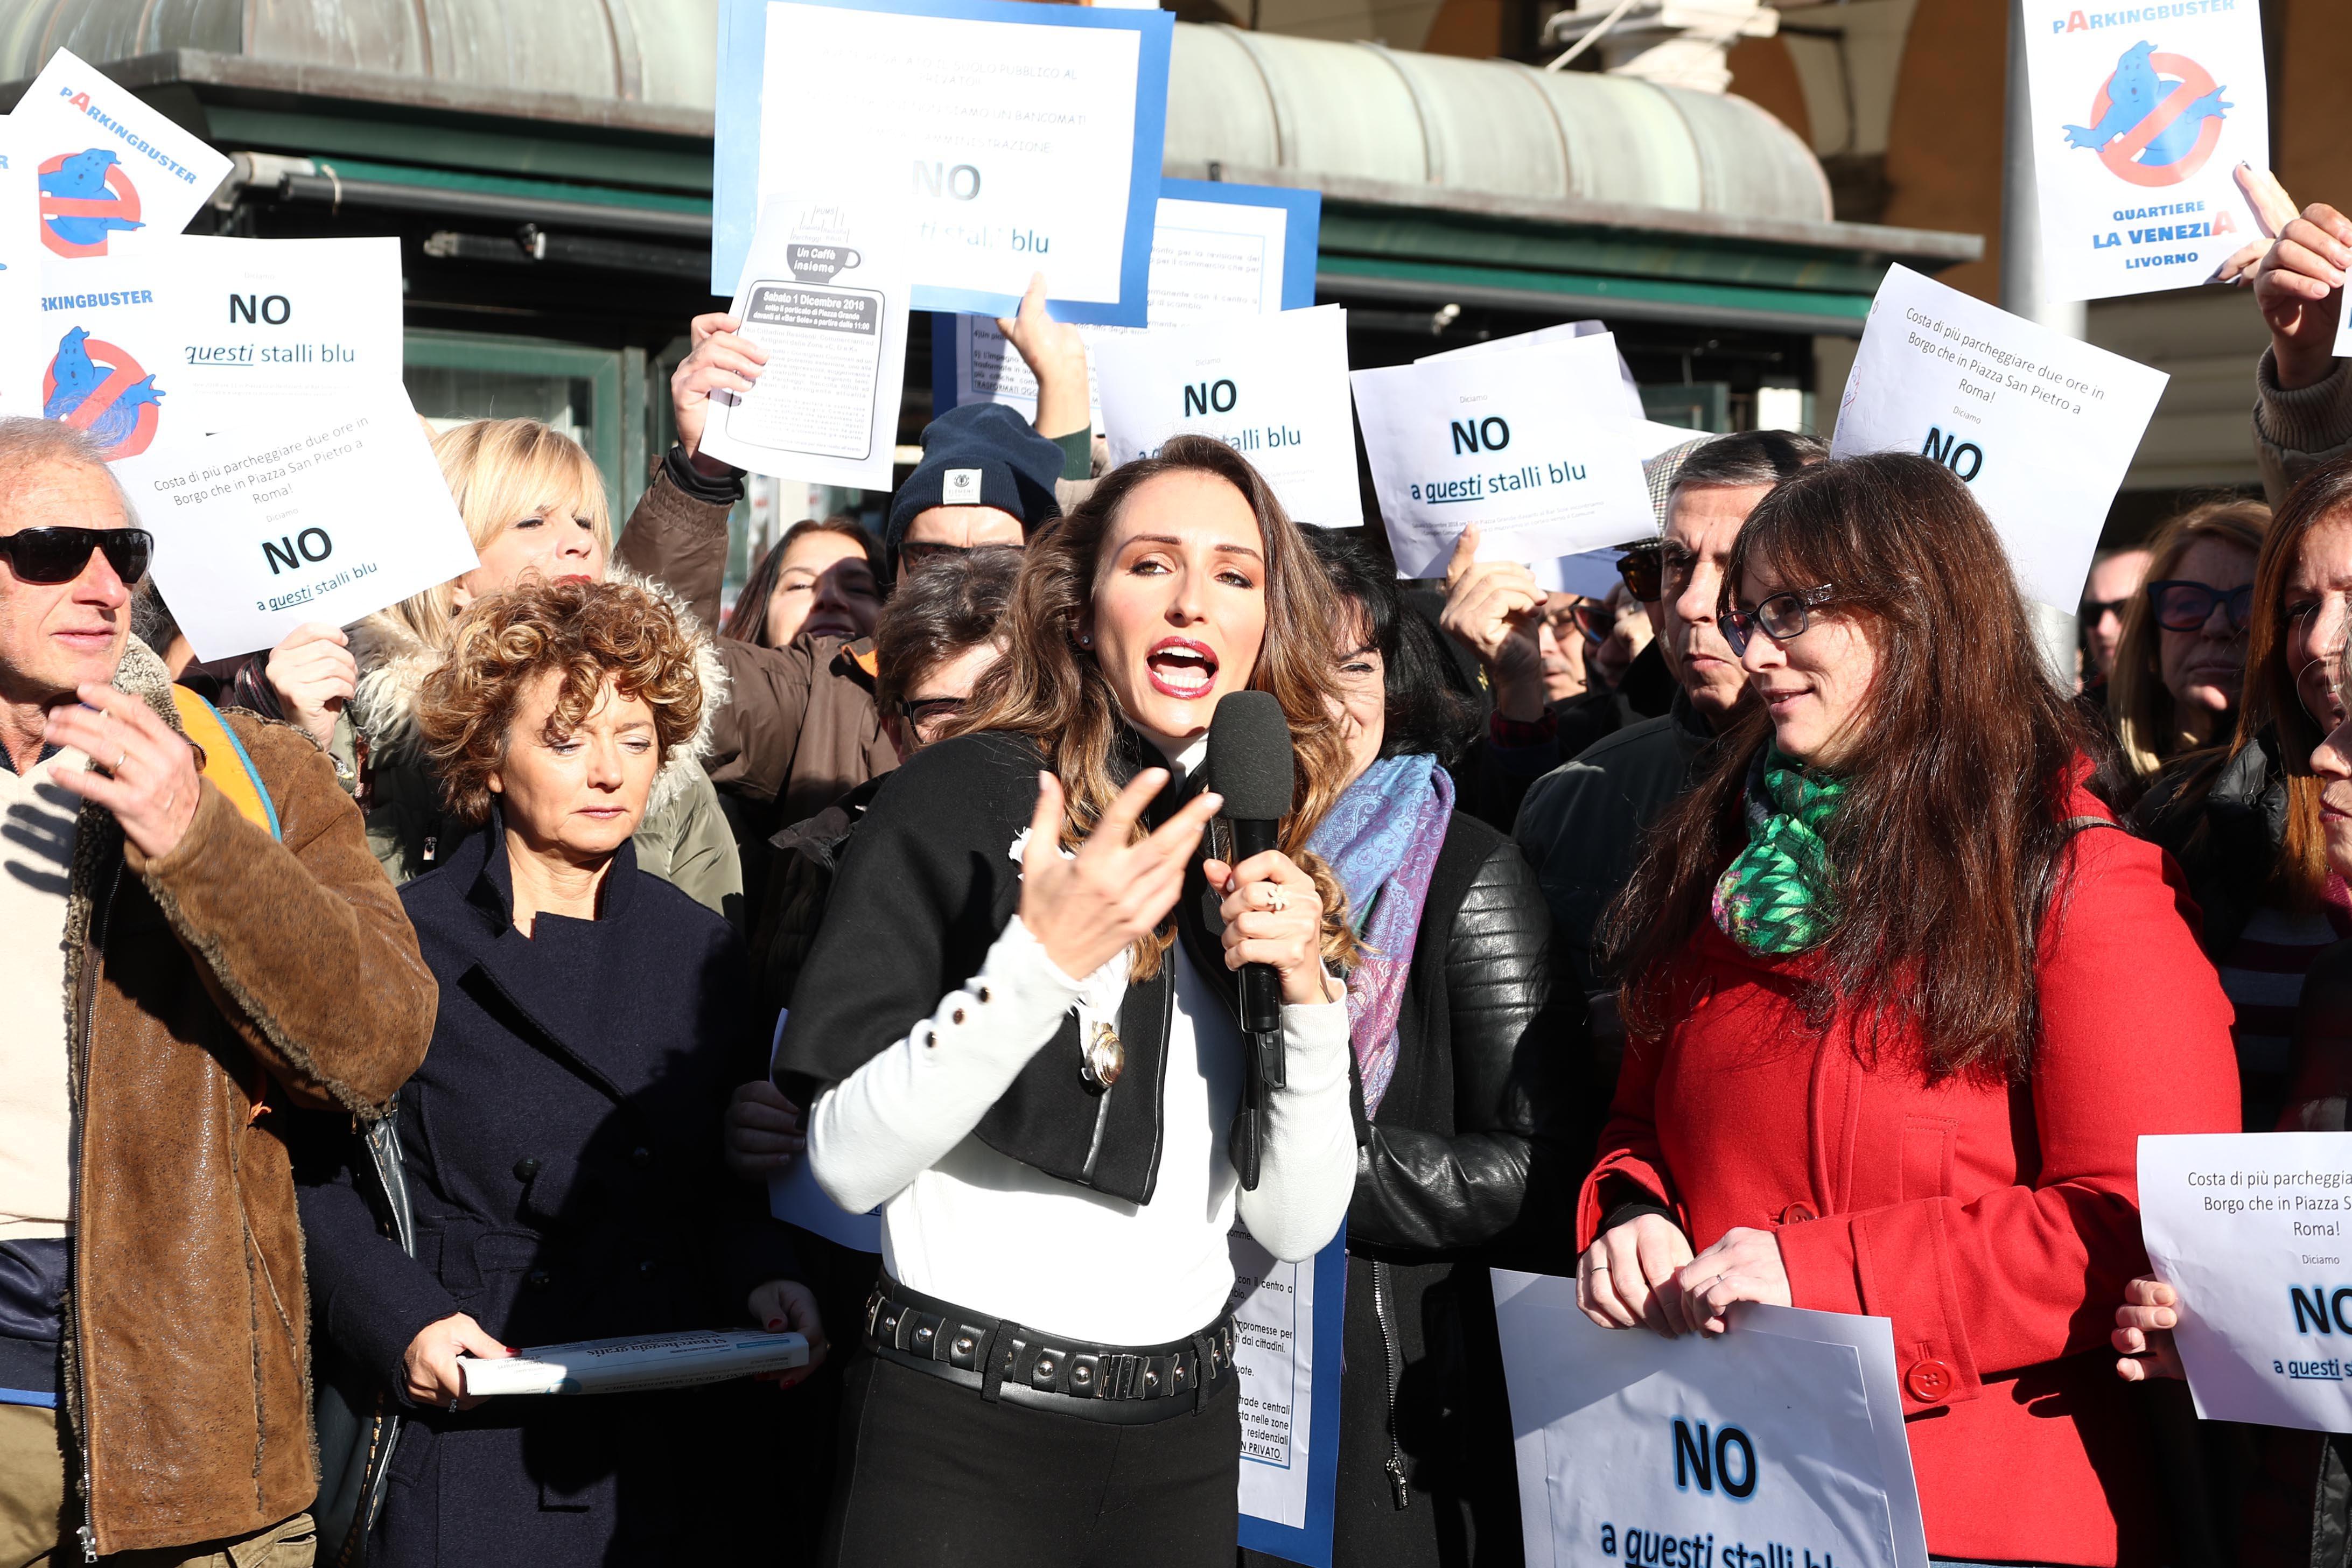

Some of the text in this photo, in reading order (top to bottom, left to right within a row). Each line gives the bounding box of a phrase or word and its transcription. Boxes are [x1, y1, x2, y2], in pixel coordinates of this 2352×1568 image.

[2052, 0, 2235, 33] PARKINGBUSTER
[953, 59, 996, 75] SUOLO
[999, 64, 1060, 79] PUBBLICO
[1063, 68, 1078, 80] AL
[993, 108, 1011, 120] UN
[60, 87, 197, 184] PARKINGBUSTER
[913, 159, 983, 201] NO
[2113, 201, 2205, 221] QUARTIERE
[2093, 211, 2237, 249] LA VENEZIA
[1011, 227, 1051, 255] blu
[797, 248, 809, 257] Un
[2125, 252, 2199, 269] LIVORNO
[230, 293, 291, 325] NO
[763, 291, 865, 311] Sabato 1 Dicembre 2018
[753, 311, 774, 319] davanti
[818, 318, 838, 327] partire
[838, 320, 853, 328] dalle
[854, 322, 870, 331] 11:00
[785, 306, 810, 316] porticato
[818, 309, 837, 317] Piazza
[837, 311, 860, 320] Grande
[185, 343, 355, 367] questi stalli blu
[1195, 357, 1221, 367] Diciamo
[1906, 307, 2105, 401] Costa di più parcheggiare due ore in
[1908, 331, 2082, 415] Borgo che in Piazza San Pietro a
[1184, 379, 1237, 418] NO
[1459, 394, 1488, 404] Diciamo
[1958, 377, 1996, 404] Roma!
[1952, 405, 1982, 424] Diciamo
[1268, 425, 1301, 448] blu
[1450, 416, 1510, 456] NO
[154, 416, 369, 492] Costa di più parcheggiare due ore in
[1921, 426, 1983, 483] NO
[173, 439, 363, 506] Borgo che in Piazza San Pietro a
[1411, 460, 1587, 505] a questi stalli blu
[253, 482, 294, 505] Roma!
[266, 508, 299, 523] Diciamo
[262, 527, 332, 575] NO
[256, 562, 377, 611] a questi stalli blu
[2188, 1171, 2225, 1186] Costa
[2230, 1171, 2243, 1186] di
[2247, 1171, 2269, 1189] più
[2204, 1196, 2245, 1214] Borgo
[2249, 1195, 2273, 1210] che
[2278, 1196, 2291, 1210] in
[2295, 1195, 2339, 1210] Piazza
[2293, 1220, 2340, 1236] Roma!
[2301, 1254, 2340, 1265] Diciamo
[1237, 1275, 1293, 1293] con il centro a
[1242, 1334, 1254, 1347] dai
[1255, 1338, 1286, 1353] cittadini.
[1280, 1328, 1292, 1340] per
[587, 1340, 628, 1358] gratis
[2273, 1360, 2284, 1374] a
[2288, 1358, 2343, 1381] questi
[1238, 1394, 1291, 1415] trade centrali
[1251, 1413, 1270, 1426] nelle
[1271, 1418, 1289, 1430] zone
[1247, 1427, 1289, 1445] residenziali
[1249, 1443, 1283, 1460] PRIVATO.
[1674, 1420, 1756, 1498] NO
[1601, 1524, 1616, 1555] a
[1625, 1530, 1713, 1568] questi
